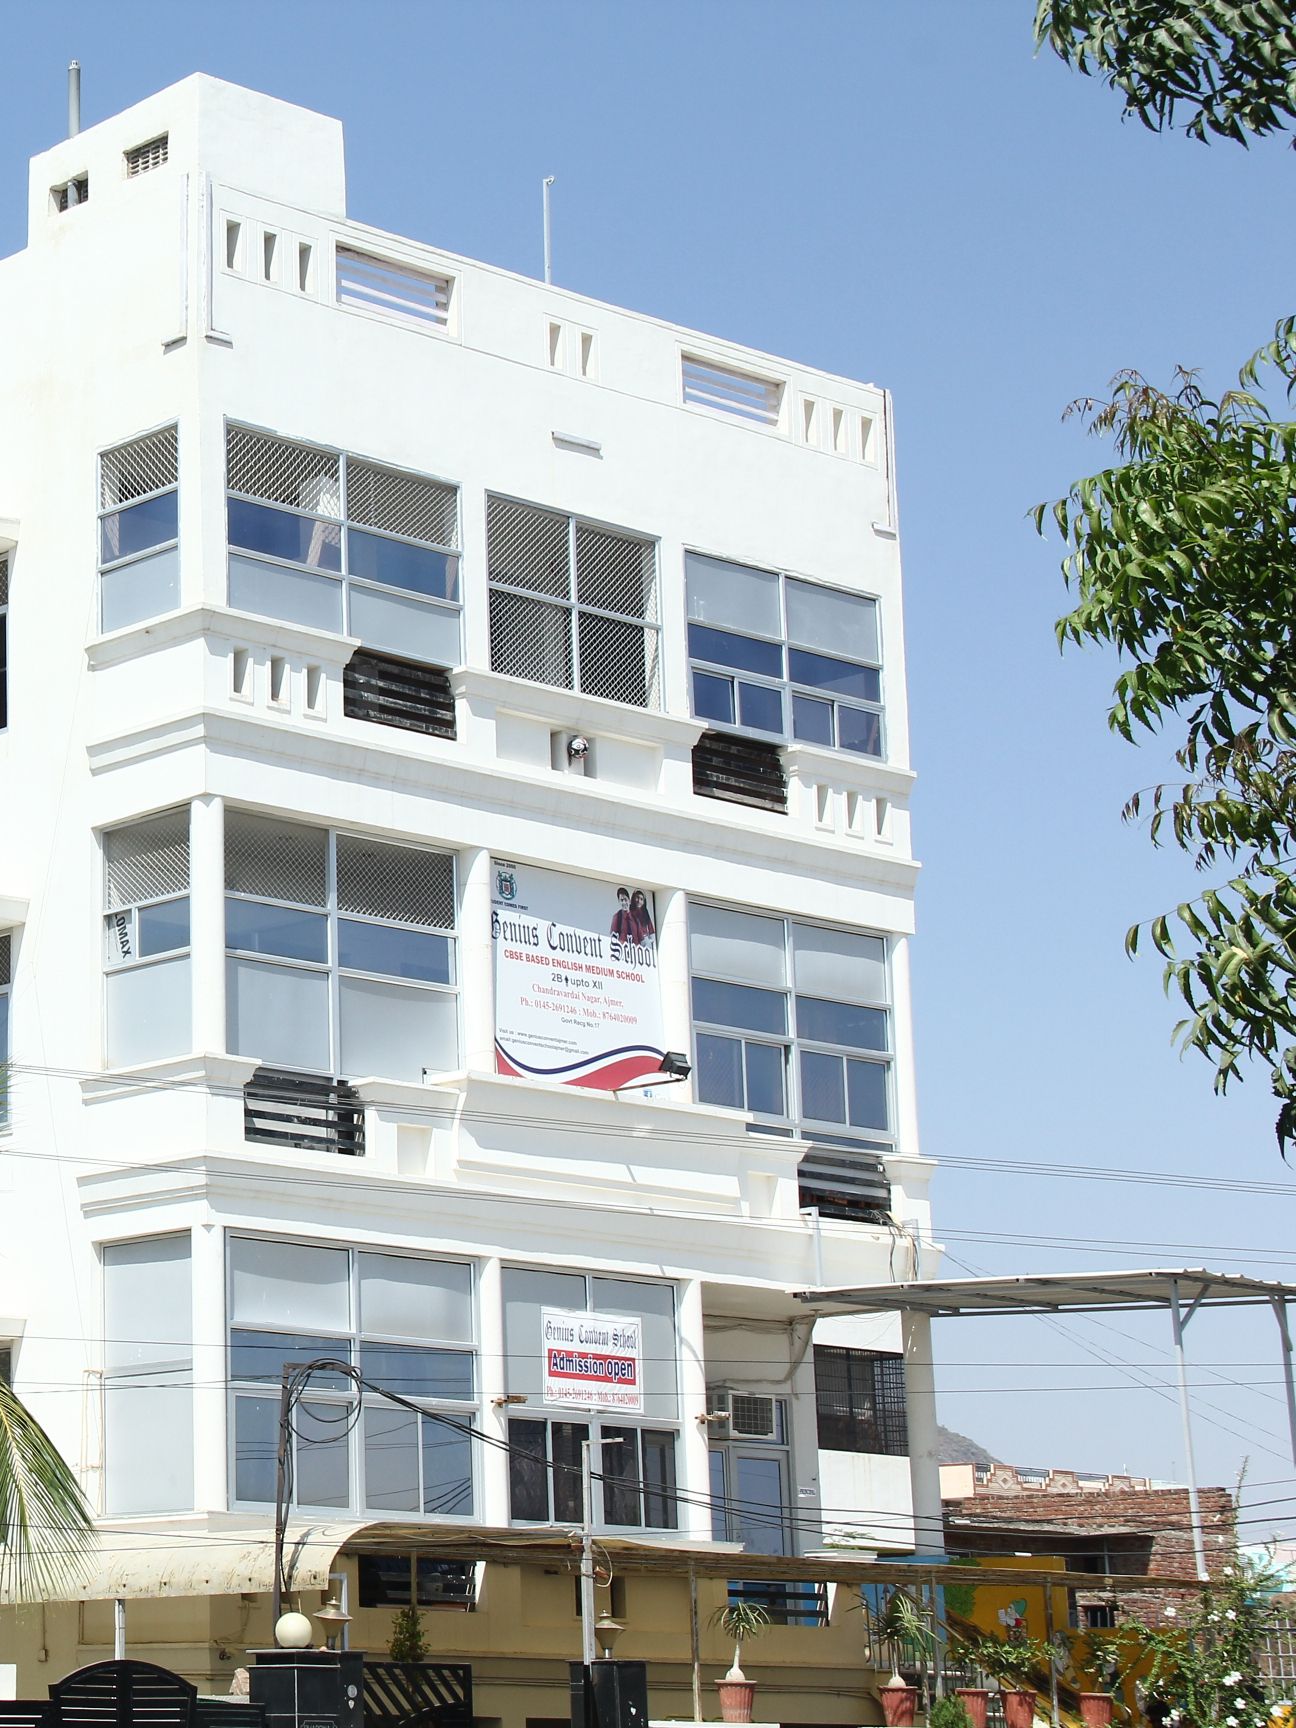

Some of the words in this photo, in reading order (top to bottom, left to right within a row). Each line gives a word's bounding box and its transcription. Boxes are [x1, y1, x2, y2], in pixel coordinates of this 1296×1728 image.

[491, 910, 540, 947] Genius
[547, 921, 603, 959] Convent
[609, 931, 657, 970] School
[504, 949, 525, 961] CBSE
[525, 953, 550, 967] BASED
[551, 958, 584, 972] ENGLISH
[584, 964, 615, 978] MEDIUM
[615, 970, 646, 984] SCHOOL
[551, 972, 563, 983] 2B
[570, 977, 590, 988] upto
[591, 980, 603, 990] XII
[545, 1320, 575, 1342] Genius
[578, 1324, 609, 1346] Convent
[612, 1328, 637, 1350] School
[551, 1352, 605, 1376] Admission
